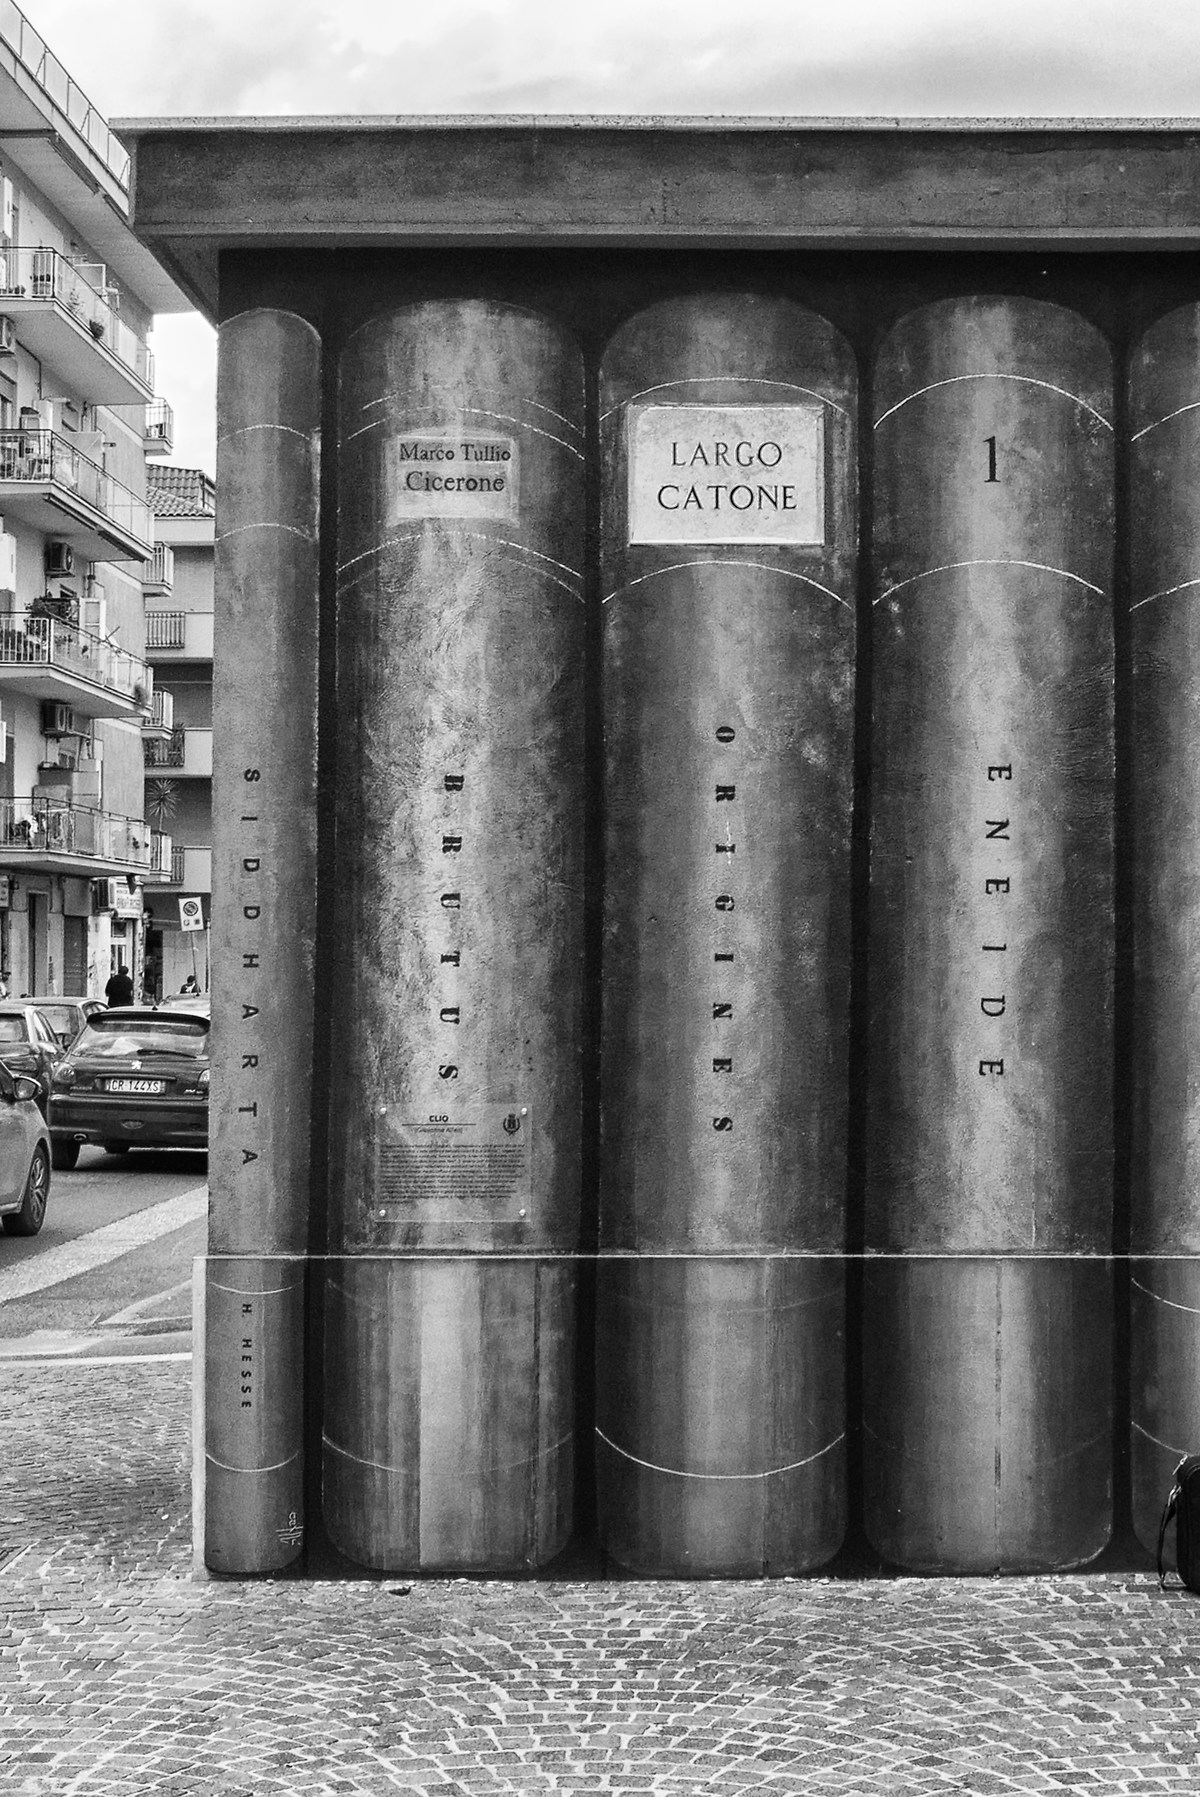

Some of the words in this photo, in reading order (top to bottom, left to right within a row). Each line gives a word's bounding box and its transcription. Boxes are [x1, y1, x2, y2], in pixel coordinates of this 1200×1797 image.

[400, 443, 455, 461] Marco
[460, 443, 511, 462] Tullio
[672, 441, 783, 468] LARGO
[983, 435, 1001, 483] 1
[406, 471, 505, 492] Cicerone
[657, 484, 797, 511] CATONE
[438, 774, 465, 1080] BRUTUS
[712, 725, 736, 1132] ORIGINES
[978, 763, 1013, 1077] ENEIDE
[238, 768, 261, 1165] SIDDHARTA
[429, 1115, 449, 1123] CLIO
[241, 1338, 254, 1408] HESSE
